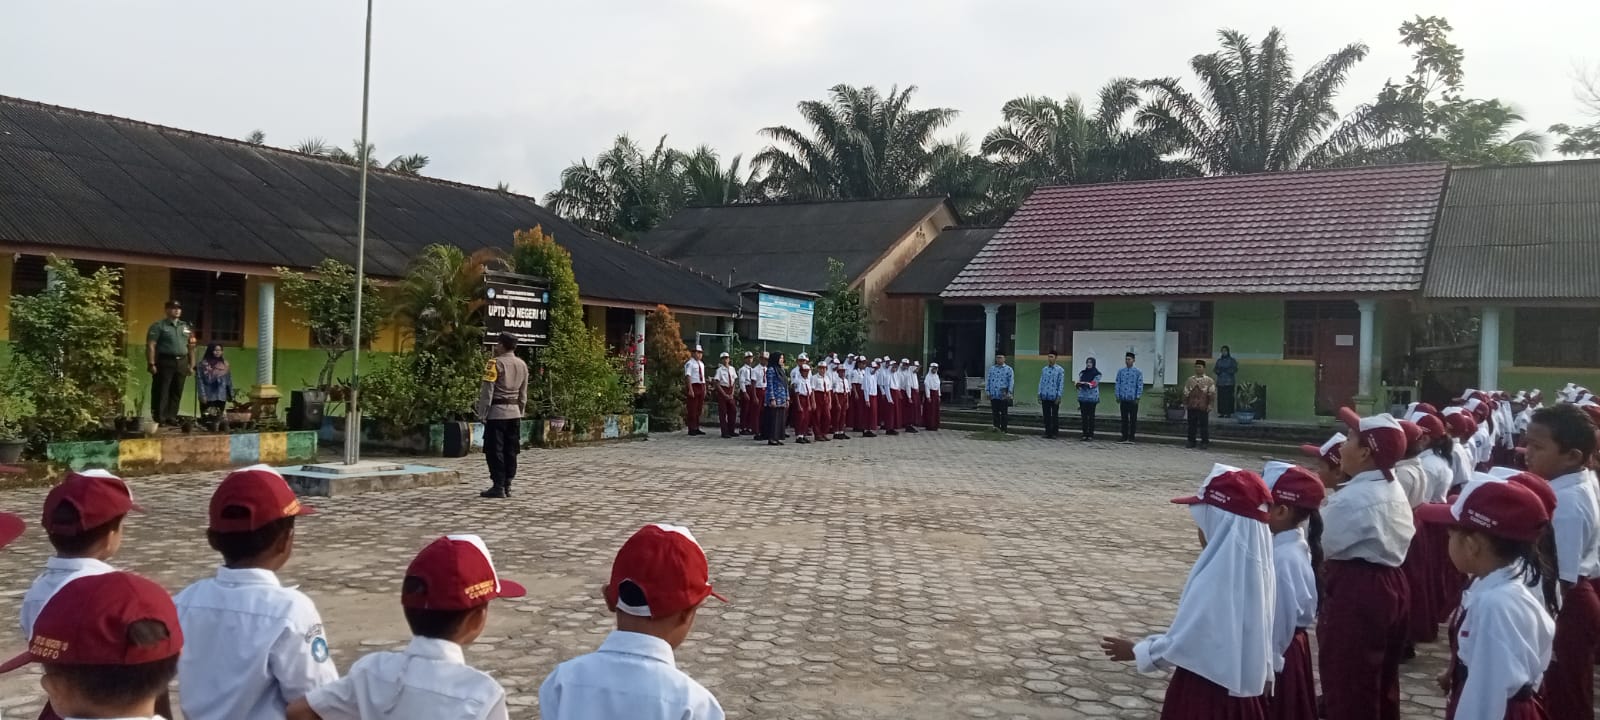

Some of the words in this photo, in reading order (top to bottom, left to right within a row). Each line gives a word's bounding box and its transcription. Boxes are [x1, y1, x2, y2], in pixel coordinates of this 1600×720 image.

[488, 304, 506, 318] UPTD
[506, 306, 516, 318] SD
[516, 307, 539, 320] NEGERI
[504, 319, 532, 329] BAKAM
